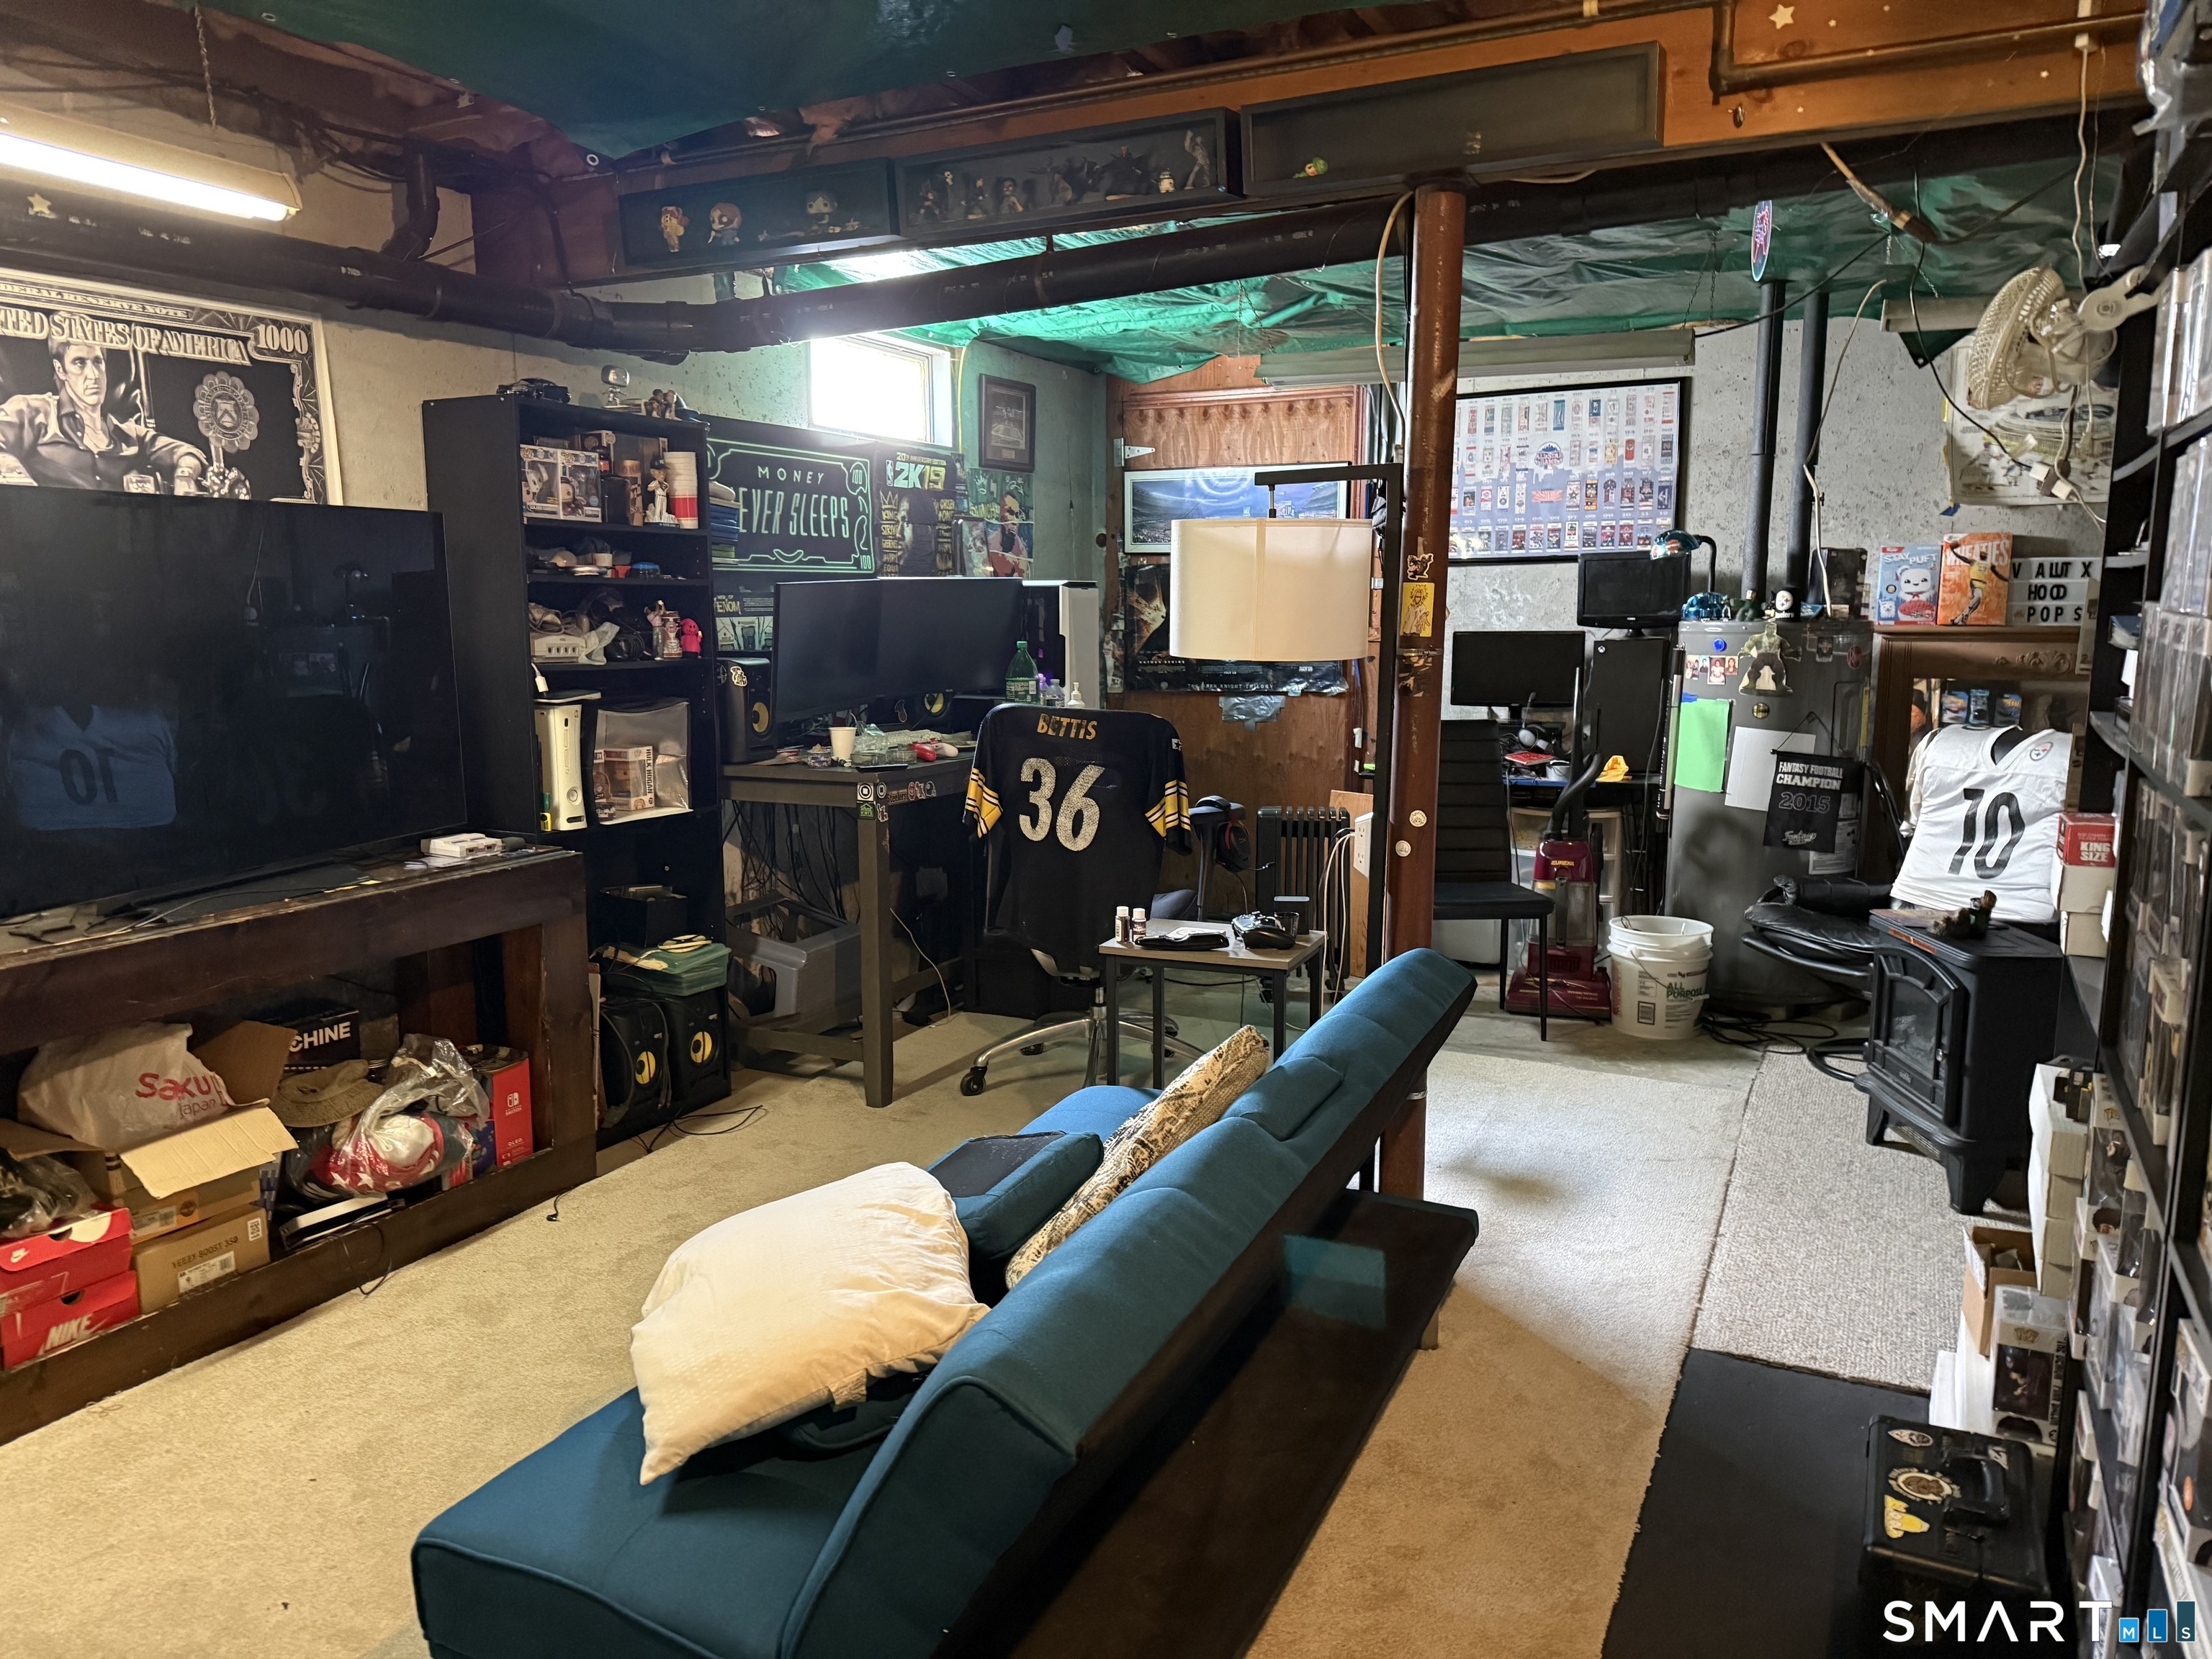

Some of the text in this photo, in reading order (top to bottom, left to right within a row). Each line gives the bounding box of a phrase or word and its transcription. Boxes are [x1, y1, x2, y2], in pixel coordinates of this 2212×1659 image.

[63, 293, 145, 311] RESERVE
[146, 305, 188, 318] NOTE
[50, 311, 130, 351] STATES
[160, 328, 252, 366] AMERICA
[256, 324, 309, 355] 1000
[757, 465, 824, 485] MONEY
[894, 461, 946, 491] 2K19
[731, 487, 850, 539] EVER SLEEPS
[860, 554, 871, 570] 100
[1884, 552, 1938, 565] STAY PUFT
[1946, 539, 2009, 566] WHEATIES
[2028, 583, 2067, 601] HOOD
[1037, 713, 1098, 740] BETTIS
[1779, 761, 1843, 779] FANTASY FOOTBALL
[1776, 773, 1843, 791] CHAMPION
[1019, 757, 1105, 852] 36
[1778, 791, 1831, 814] 2015
[1947, 788, 2026, 879] 10
[2080, 841, 2111, 853] KING
[2080, 851, 2109, 863] SIZE
[1666, 981, 1685, 992] ALL
[508, 1138, 523, 1146] OLED
[198, 1243, 223, 1259] BOOST
[45, 1313, 94, 1351] NIKE
